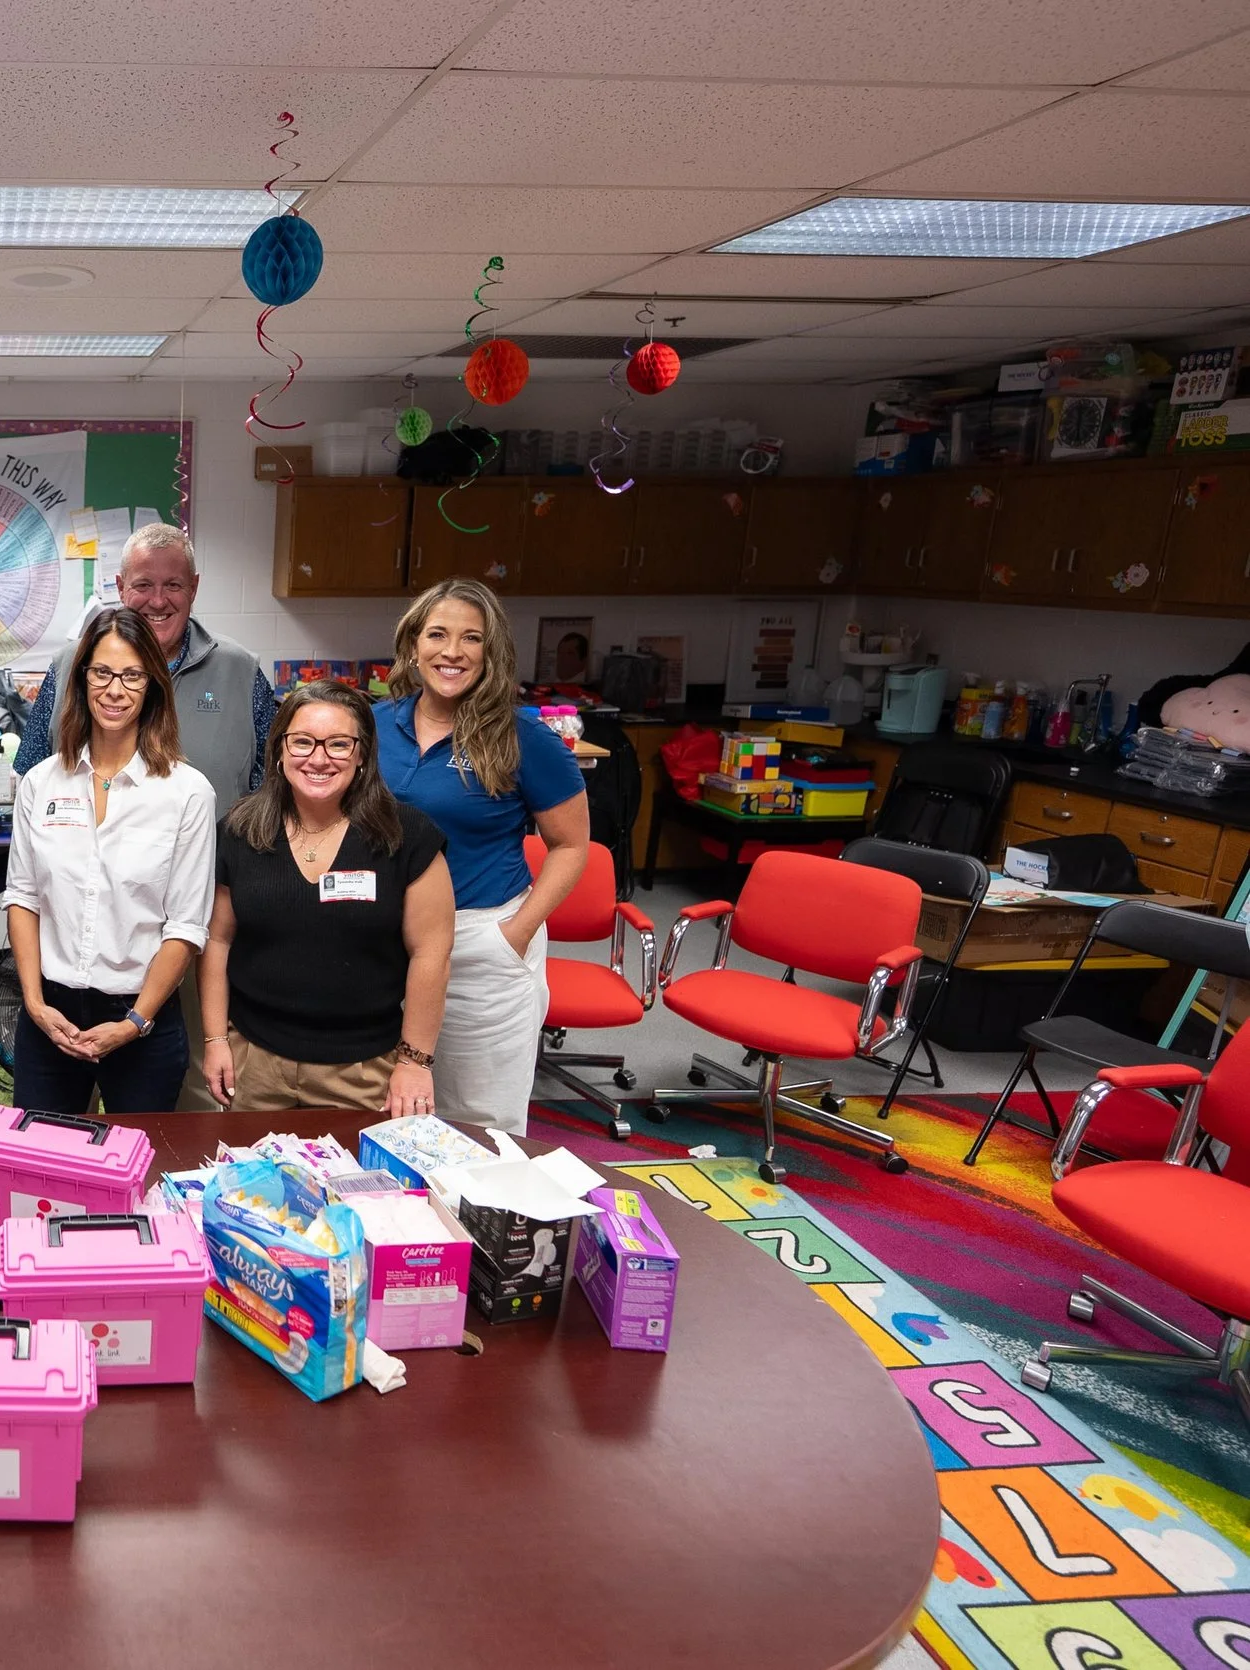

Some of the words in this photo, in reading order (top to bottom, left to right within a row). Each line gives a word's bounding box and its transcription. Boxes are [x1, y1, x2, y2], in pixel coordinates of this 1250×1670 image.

[1182, 415, 1228, 429] LADDER
[1180, 428, 1227, 447] TOSS
[0, 454, 39, 489] THIS
[32, 478, 68, 512] WAY
[197, 699, 220, 709] Park
[1029, 862, 1048, 871] HOCK
[511, 1234, 528, 1242] teen
[402, 1245, 445, 1259] Carefree
[744, 1227, 831, 1275] 2
[220, 1245, 294, 1301] always
[241, 1272, 267, 1297] MAXI
[929, 1378, 1041, 1449] 5
